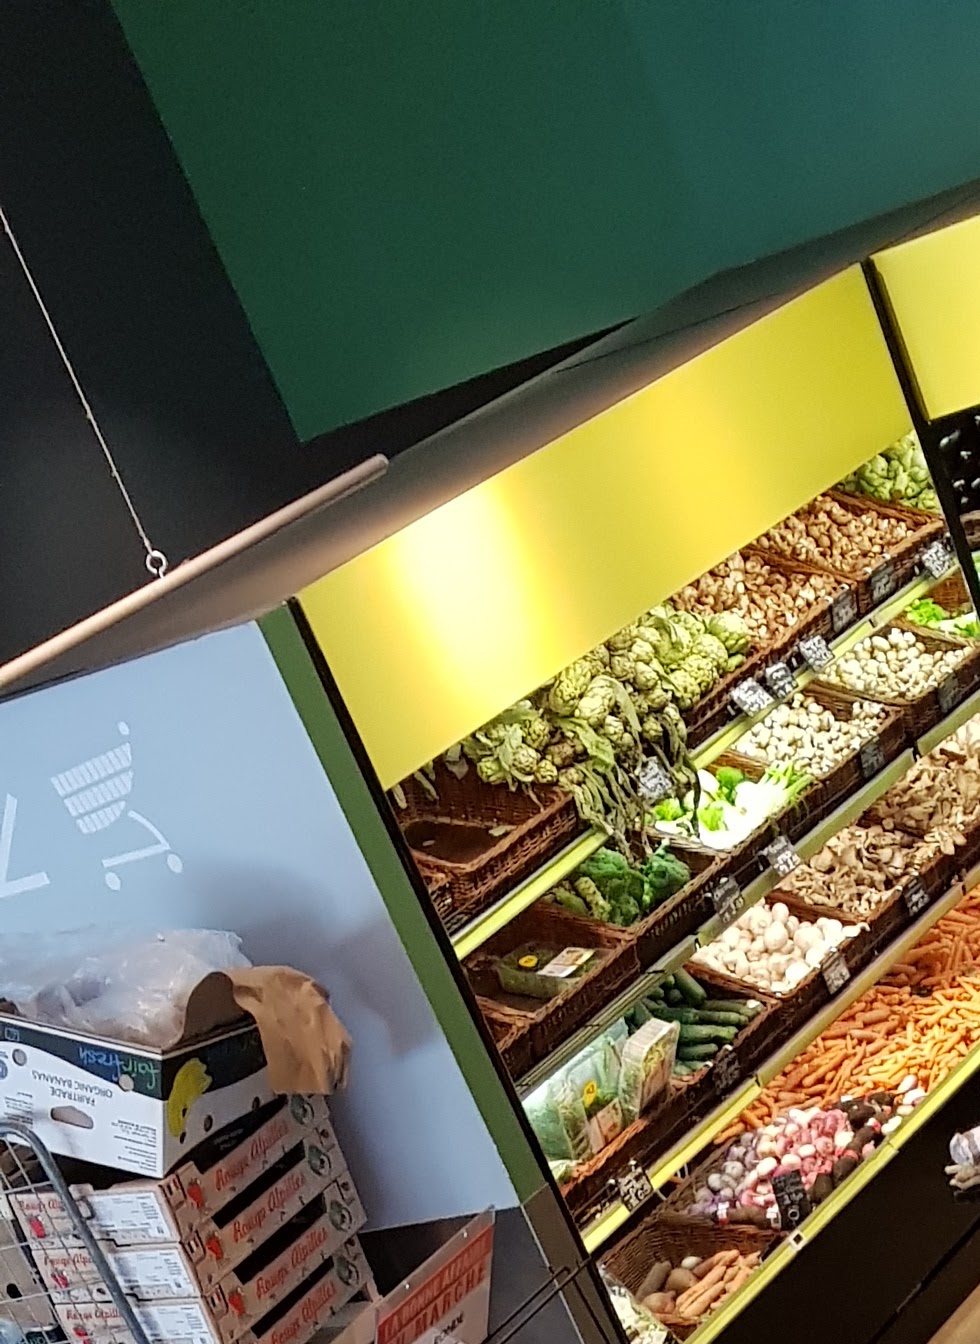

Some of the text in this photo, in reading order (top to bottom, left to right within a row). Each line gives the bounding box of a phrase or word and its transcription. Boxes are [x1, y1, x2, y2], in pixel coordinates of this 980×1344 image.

[32, 1069, 113, 1099] ORGANIC BANANAS
[51, 1086, 96, 1106] FAIRTRADE
